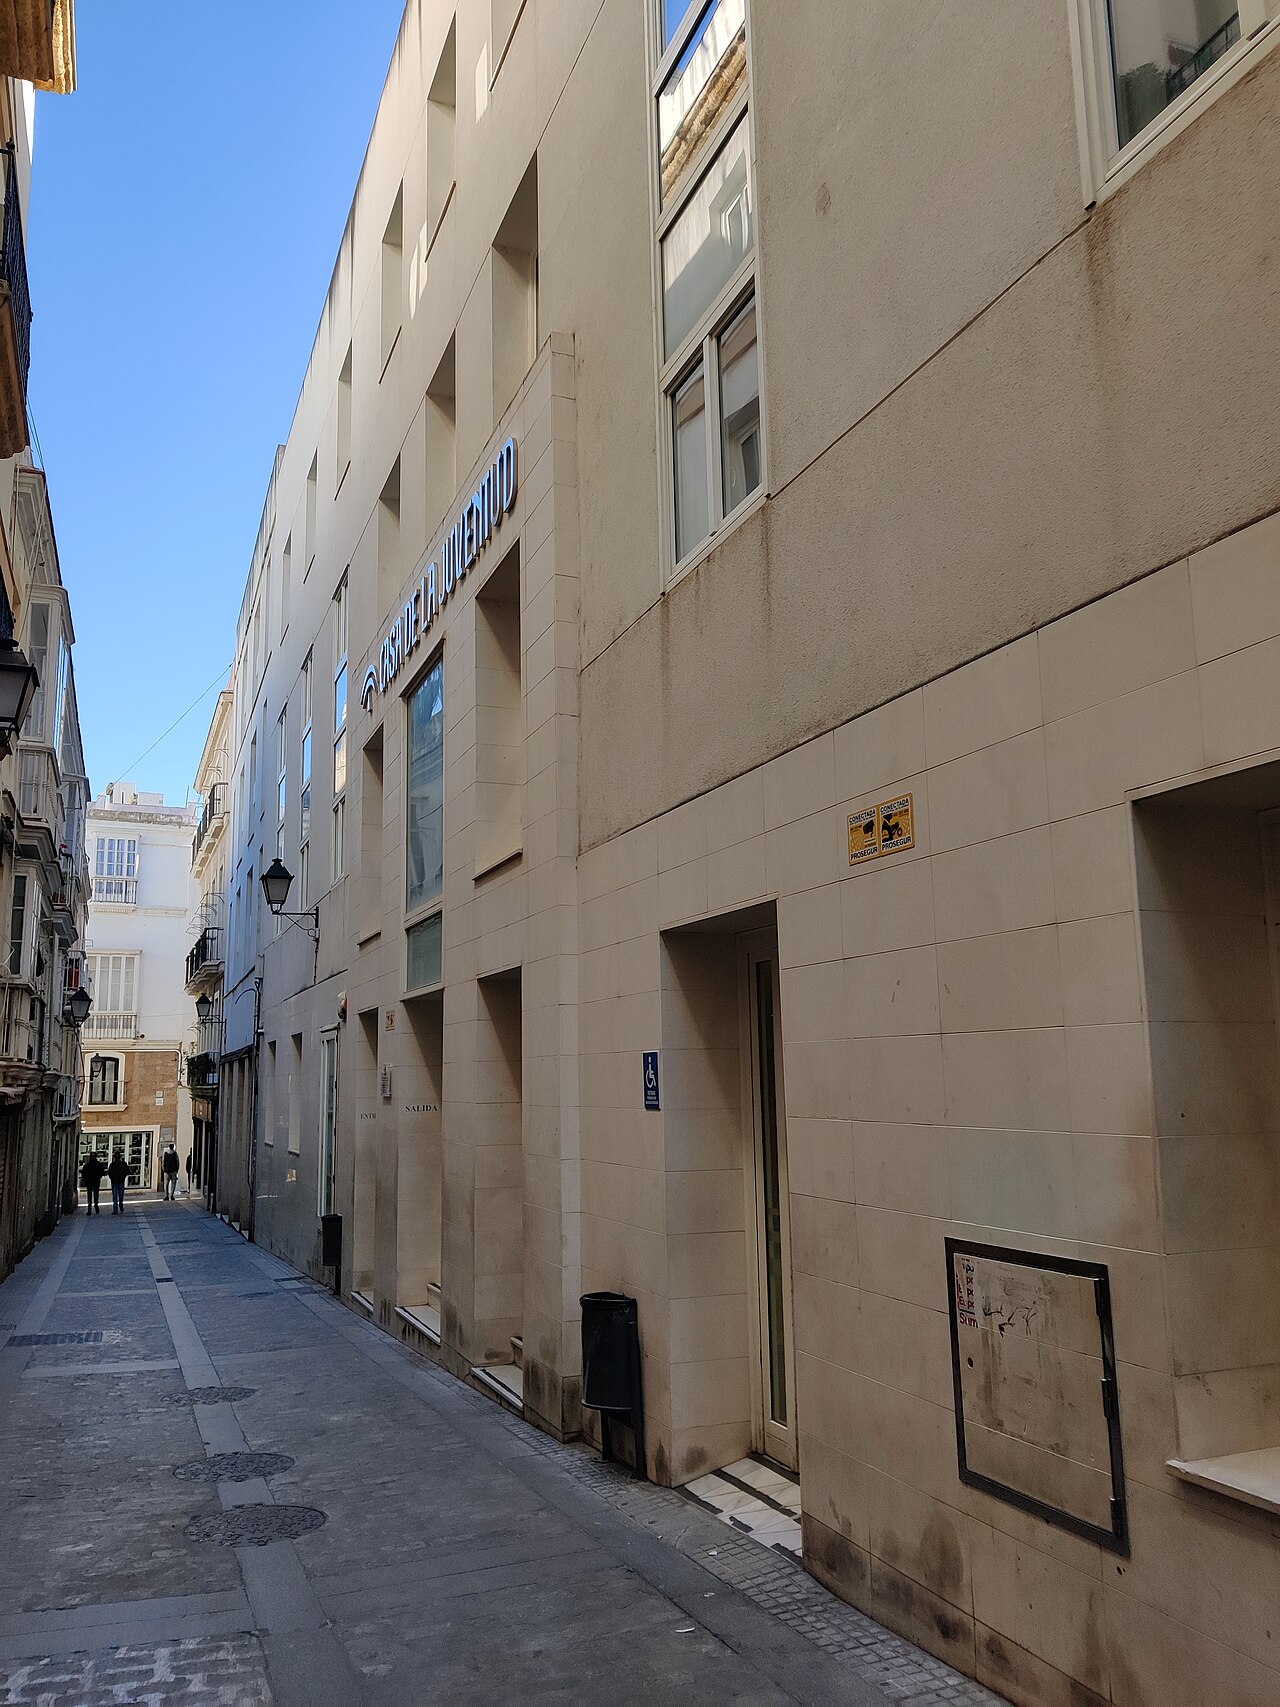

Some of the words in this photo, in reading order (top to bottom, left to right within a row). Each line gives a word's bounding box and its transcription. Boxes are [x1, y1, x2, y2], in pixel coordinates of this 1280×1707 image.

[379, 616, 404, 692] CASA
[404, 588, 420, 657] DE
[421, 562, 439, 633] LA
[439, 437, 518, 605] JUVENTUD
[880, 798, 909, 813] CONECTADA
[849, 809, 876, 823] CONECTADA
[881, 836, 912, 851] PROSEGUR
[850, 846, 878, 861] PROSEGUR
[405, 1104, 438, 1112] SALIDA
